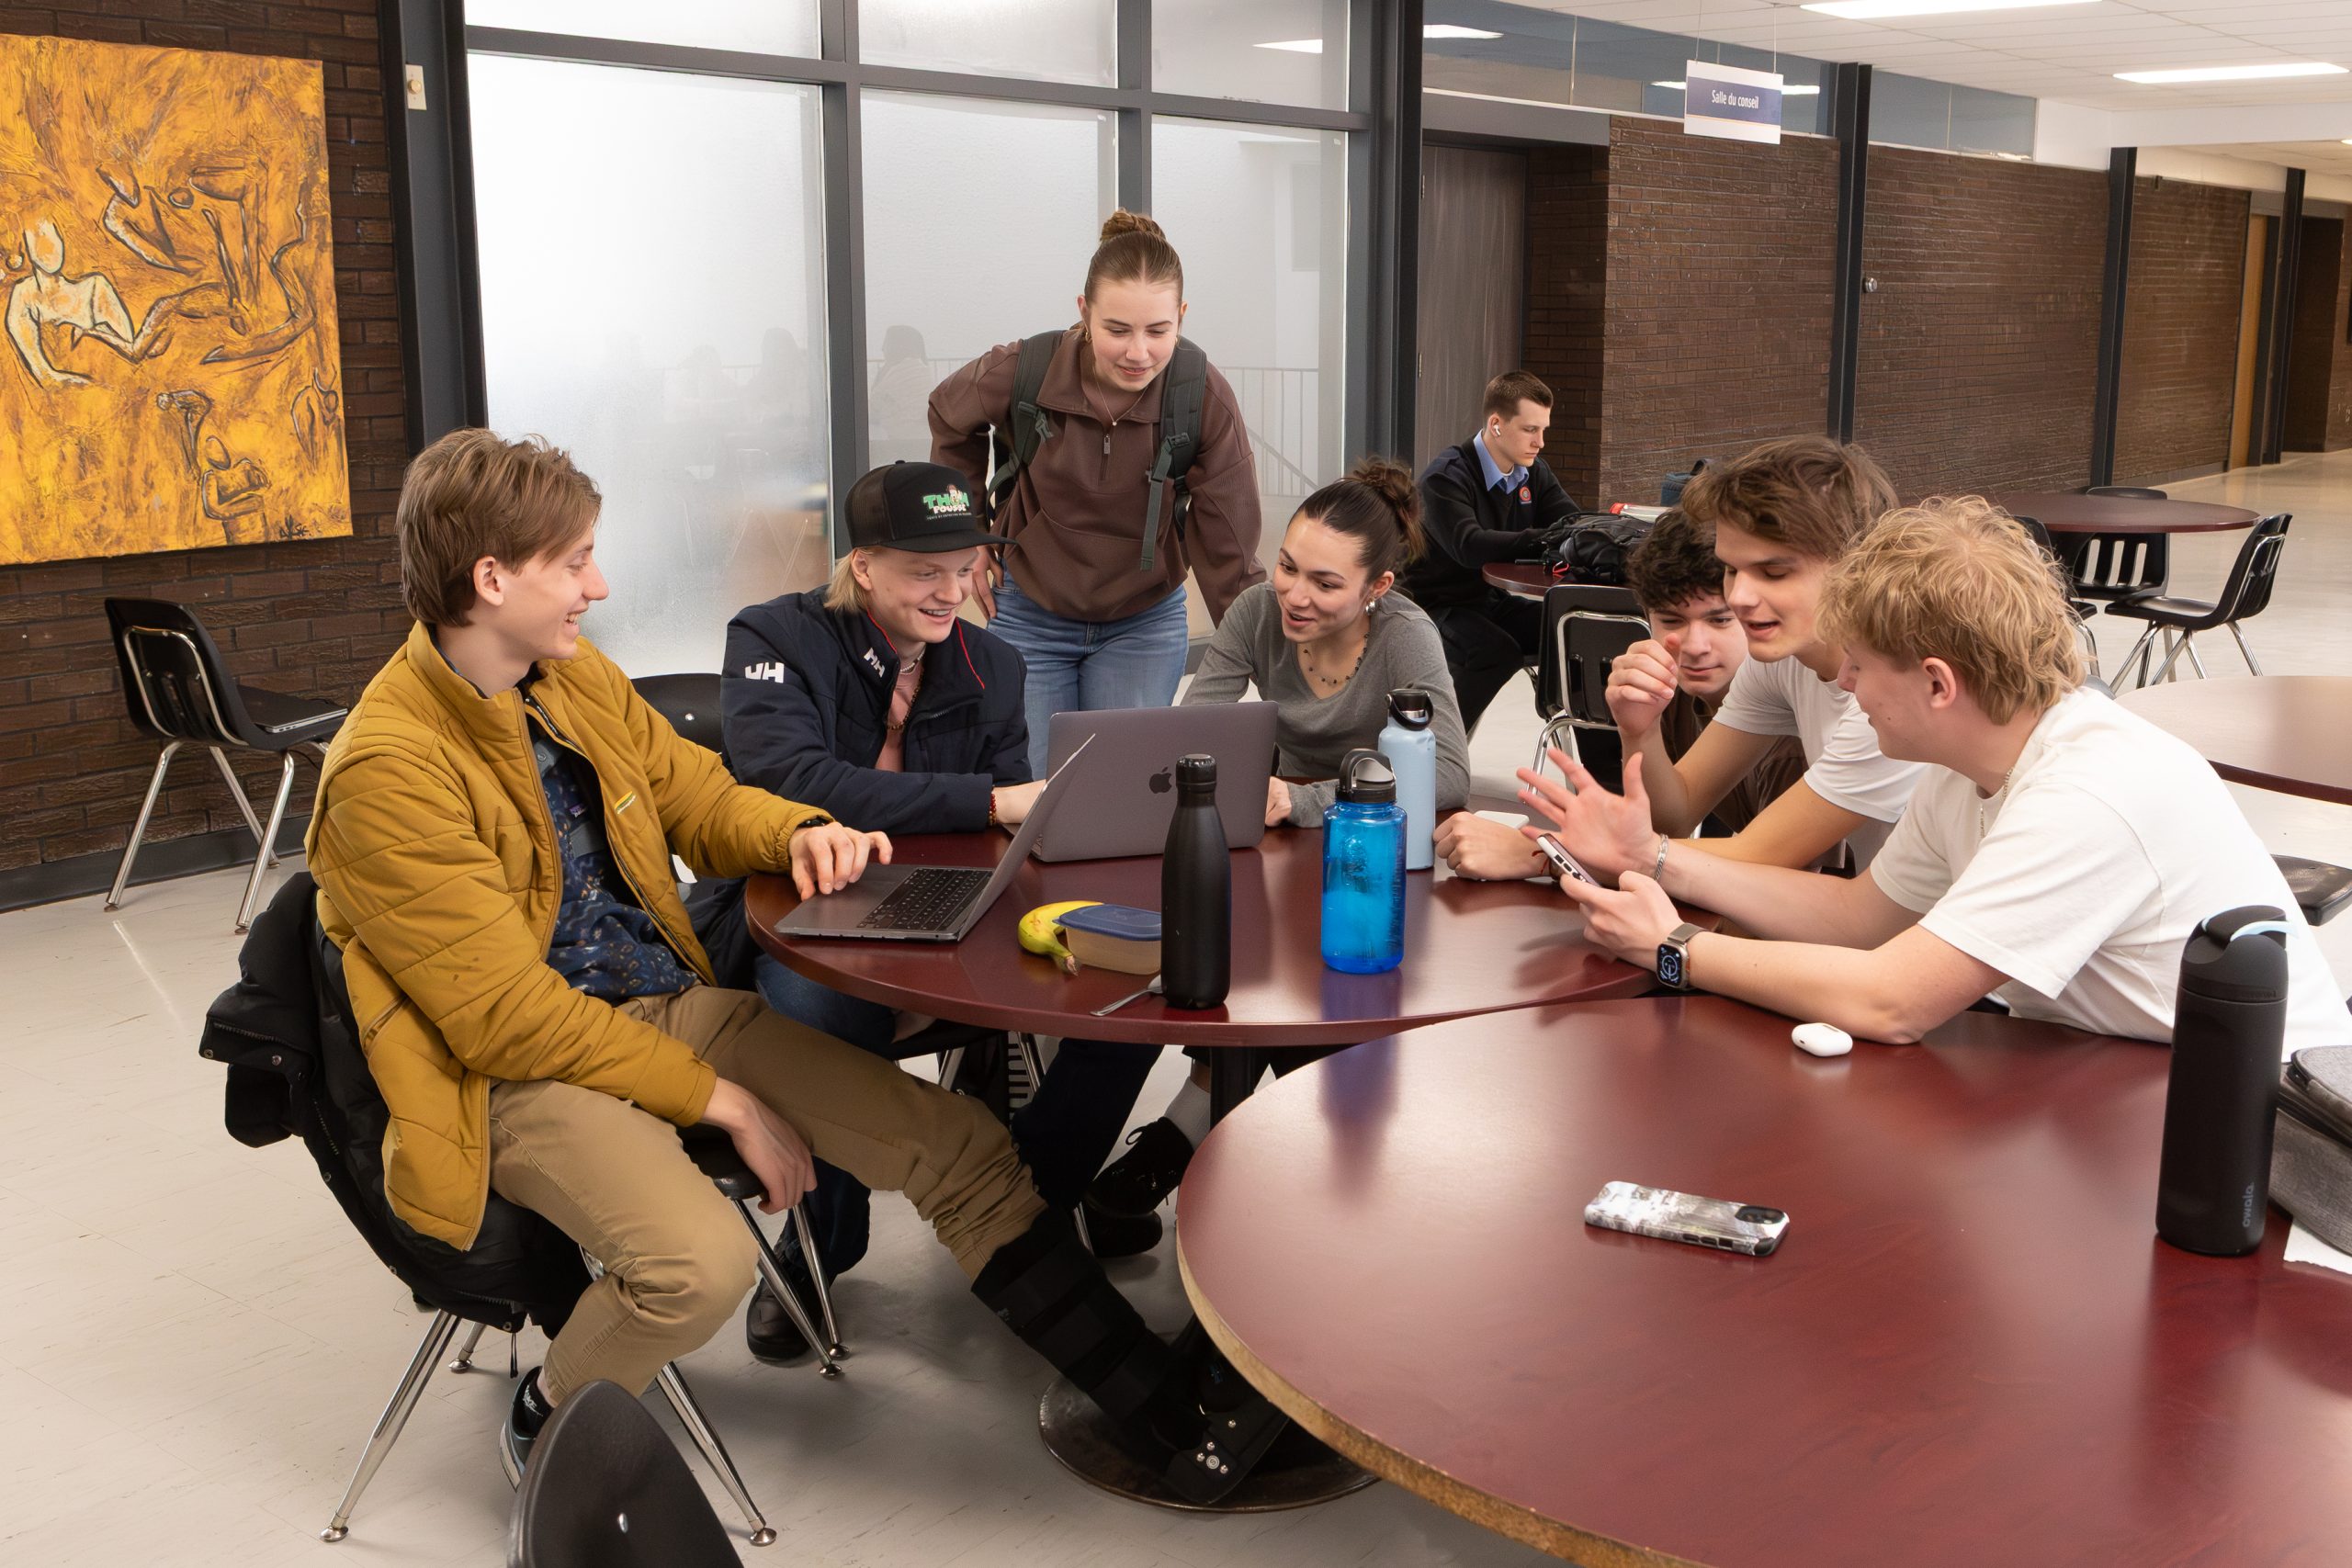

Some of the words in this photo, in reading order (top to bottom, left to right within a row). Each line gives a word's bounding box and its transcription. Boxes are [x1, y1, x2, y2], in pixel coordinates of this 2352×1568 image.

[1712, 89, 1727, 105] Salle
[1727, 92, 1736, 106] du
[1737, 96, 1759, 109] conseil
[923, 492, 970, 509] THM
